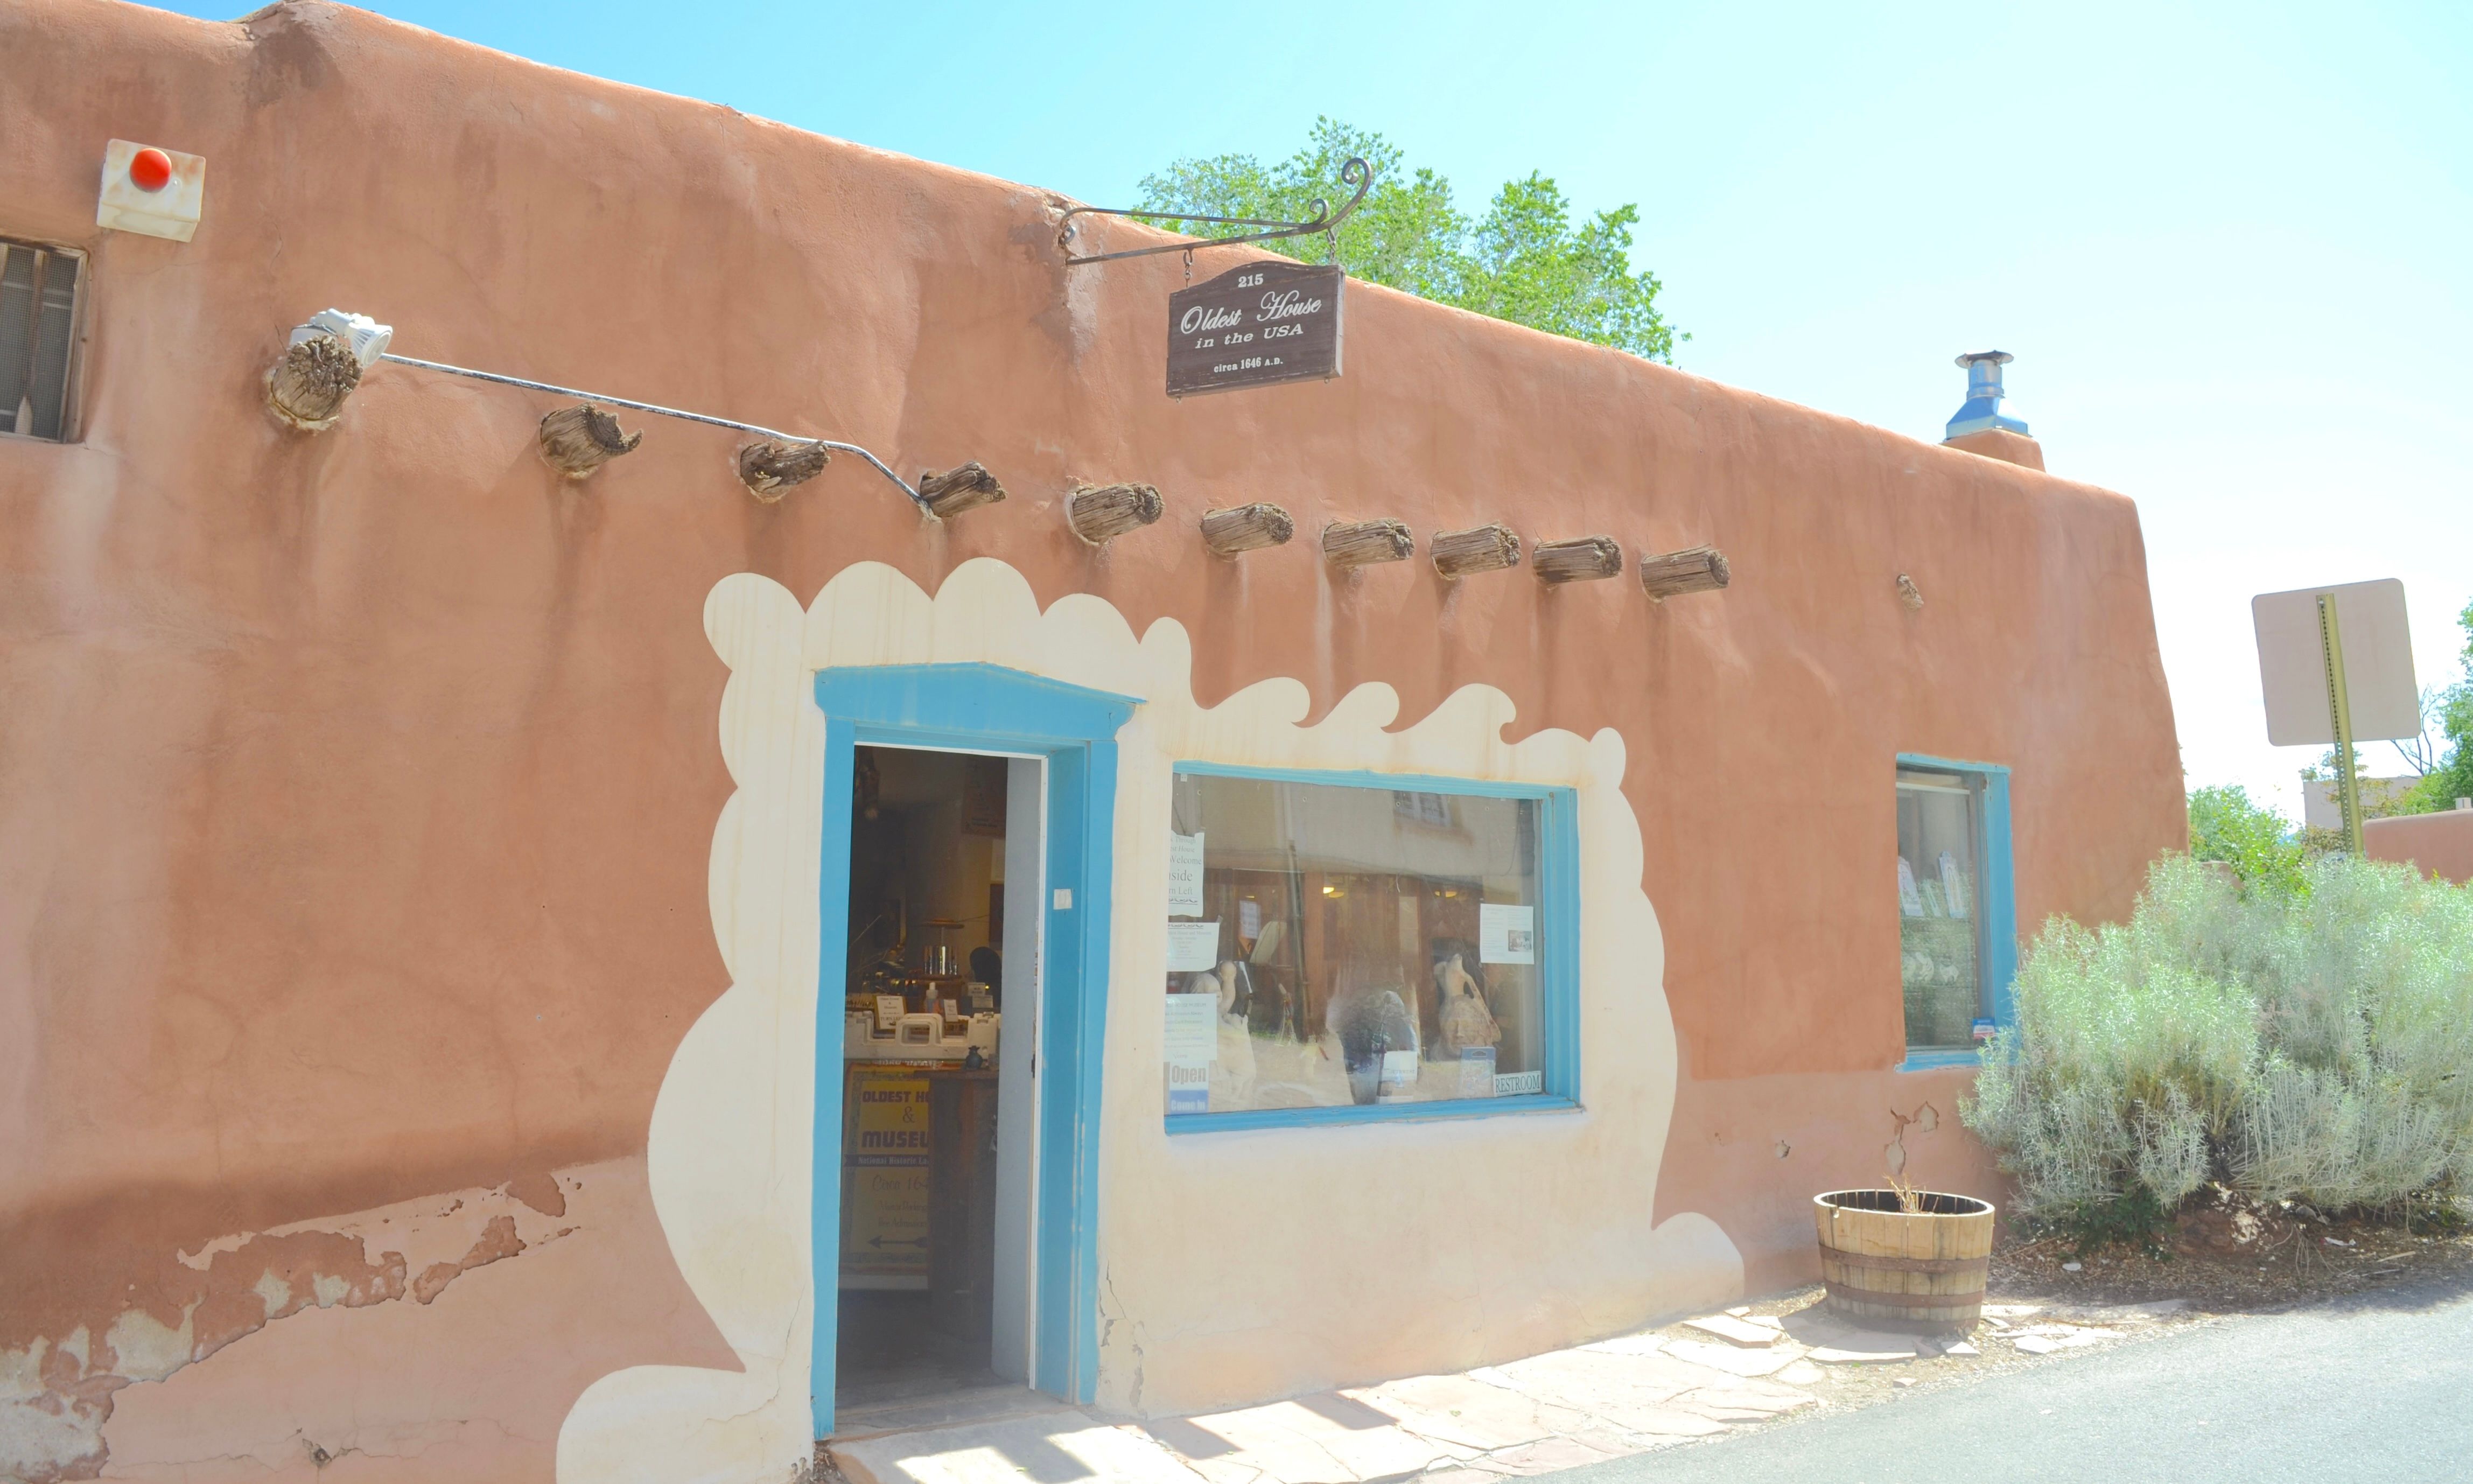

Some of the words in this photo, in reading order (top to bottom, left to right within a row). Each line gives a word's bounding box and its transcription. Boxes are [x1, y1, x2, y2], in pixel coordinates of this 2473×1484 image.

[1238, 274, 1264, 288] 215
[1180, 306, 1242, 334] Oldest
[1256, 290, 1321, 321] House
[1195, 338, 1214, 348] in
[1224, 332, 1253, 345] the
[1263, 324, 1304, 339] USA
[1214, 361, 1238, 373] circa
[1241, 357, 1262, 369] 1646
[1264, 357, 1283, 366] A.D.
[1170, 855, 1202, 865] Welcome
[1178, 886, 1193, 895] Left
[1172, 1065, 1206, 1084] Open
[1495, 1075, 1539, 1093] RESTROOM
[863, 1091, 911, 1103] OLDEST
[1172, 1100, 1195, 1111] Come
[903, 1106, 915, 1123] &
